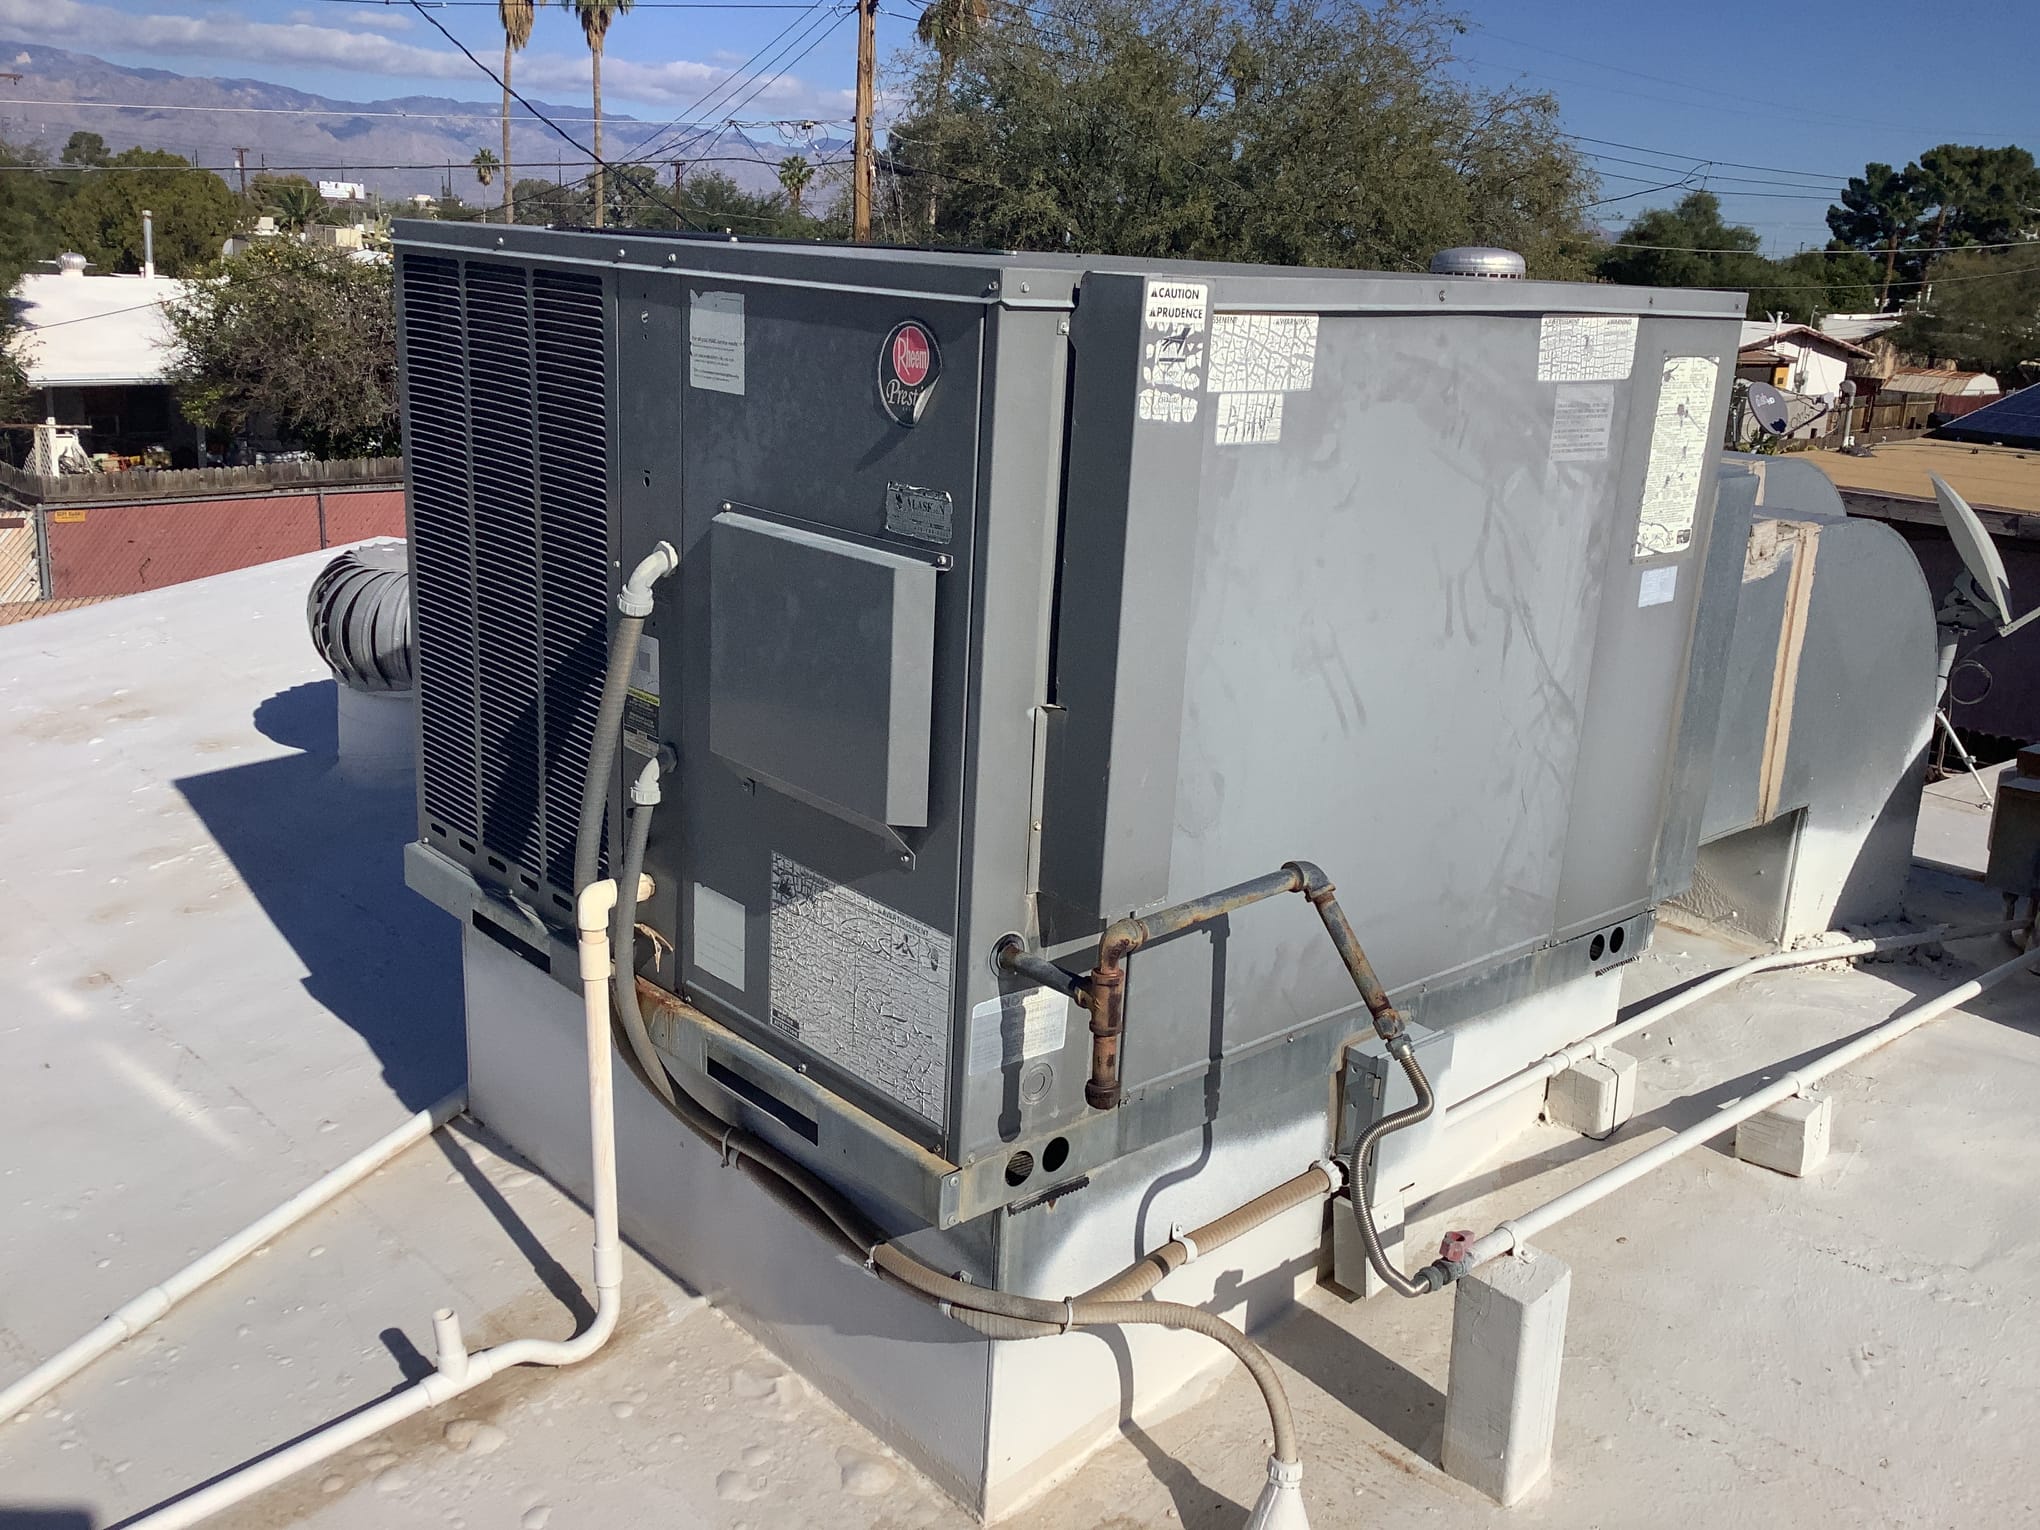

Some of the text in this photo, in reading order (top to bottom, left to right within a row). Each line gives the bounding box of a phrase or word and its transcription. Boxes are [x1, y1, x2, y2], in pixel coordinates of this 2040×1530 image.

[1159, 287, 1200, 300] CAUTION
[1157, 307, 1203, 319] PRUDENCE
[897, 328, 928, 376] Rheem
